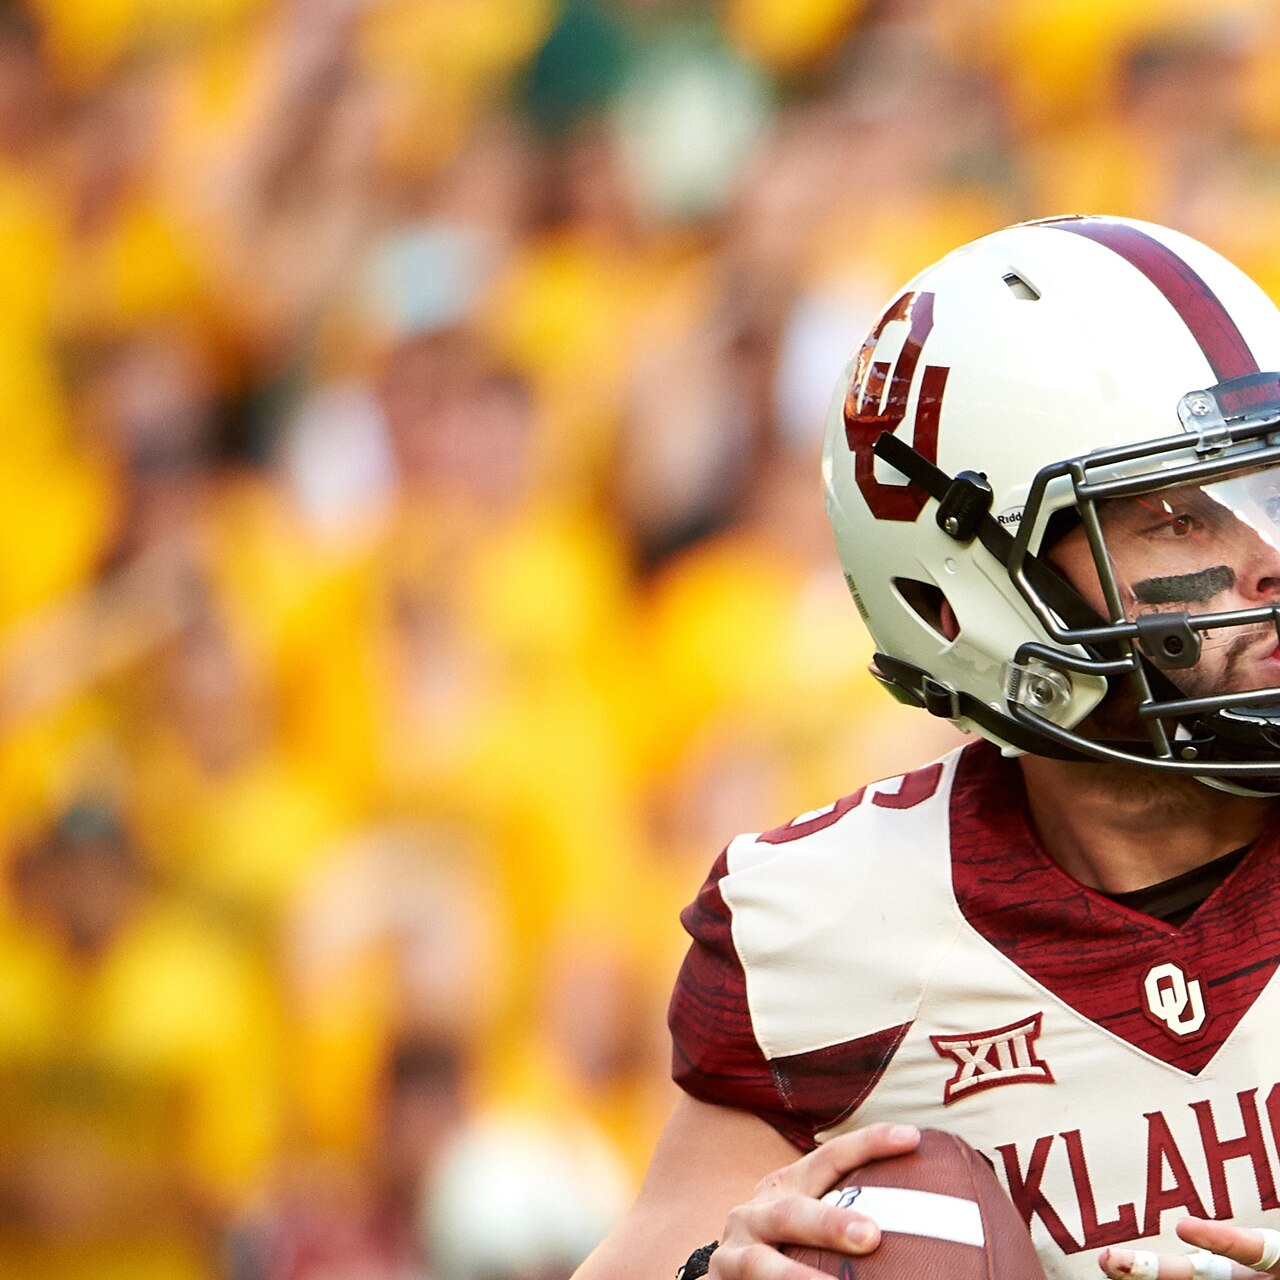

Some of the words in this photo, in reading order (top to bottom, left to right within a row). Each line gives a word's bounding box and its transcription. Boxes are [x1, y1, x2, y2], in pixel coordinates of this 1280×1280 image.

[844, 291, 949, 521] OU
[997, 512, 1023, 525] Ridd
[1144, 963, 1206, 1036] OU
[936, 1014, 1051, 1101] XII
